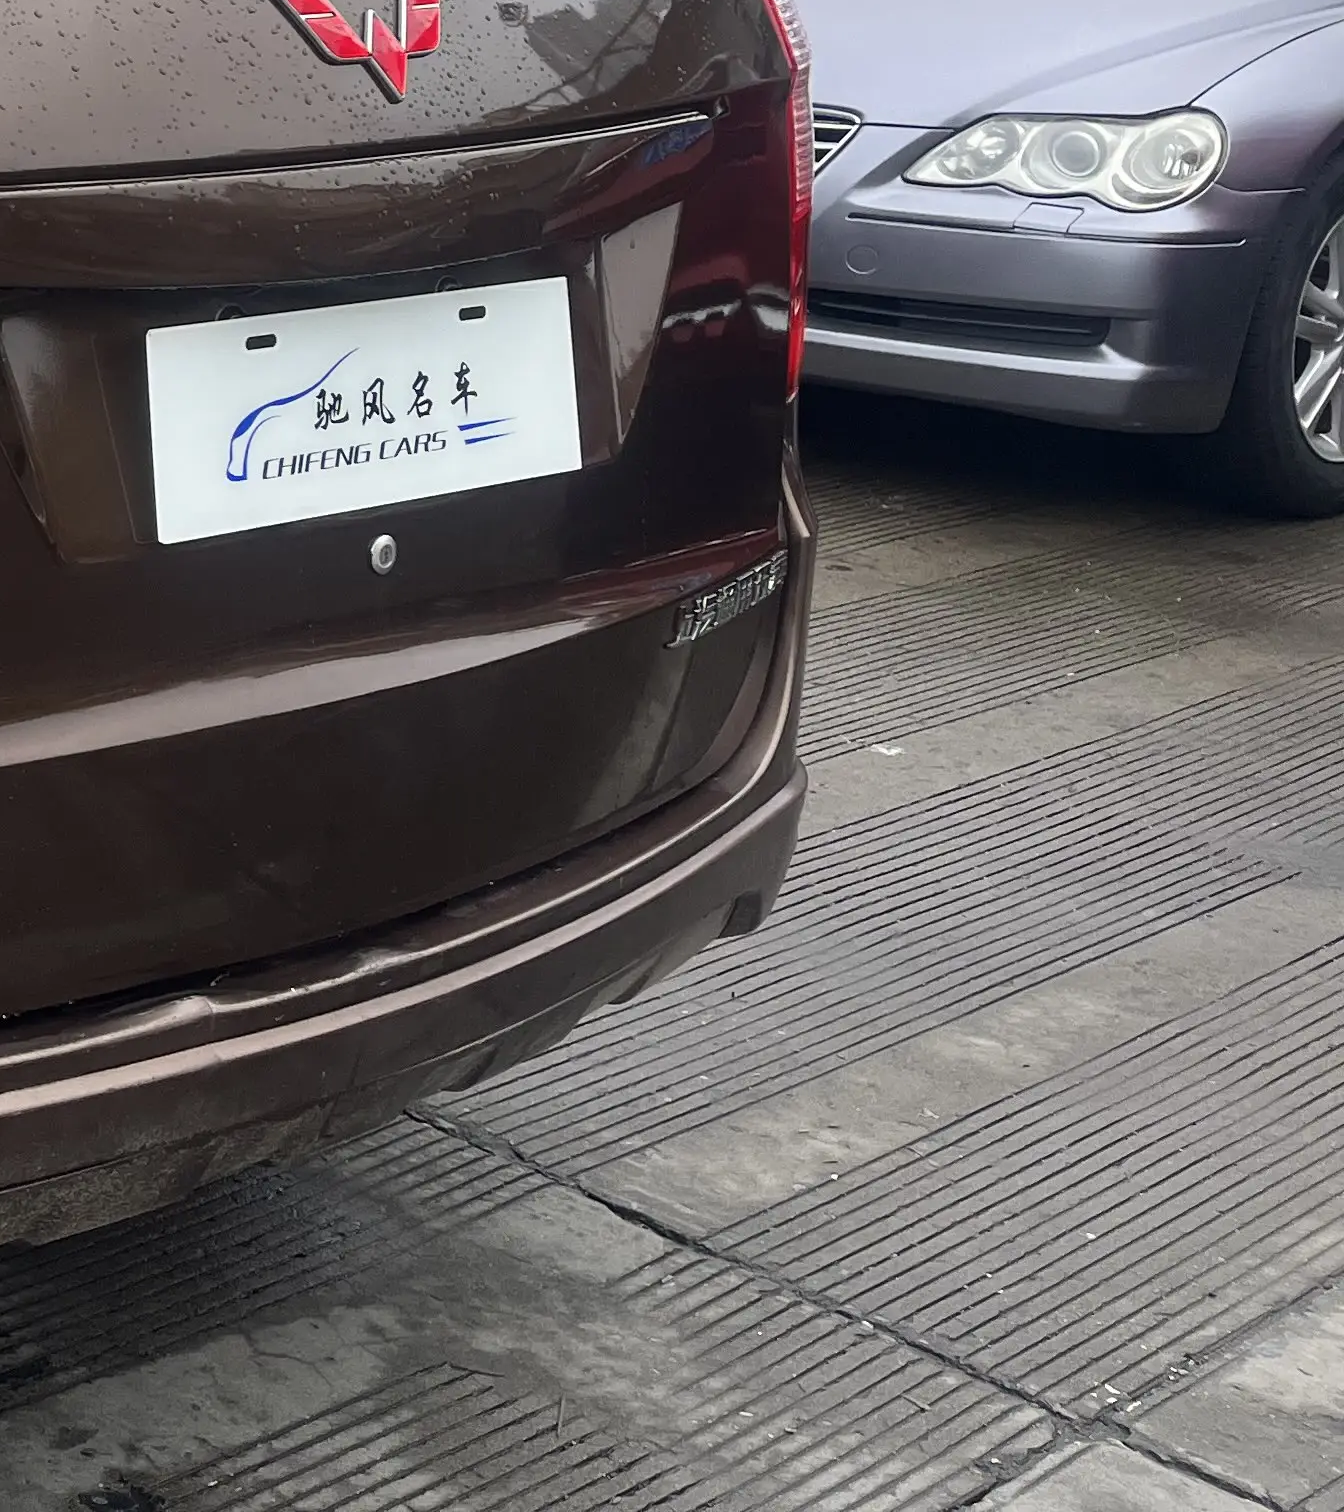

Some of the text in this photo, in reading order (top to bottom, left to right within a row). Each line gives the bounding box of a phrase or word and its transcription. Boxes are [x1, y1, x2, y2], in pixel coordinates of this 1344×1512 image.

[314, 361, 478, 430] 驰风名车
[263, 430, 447, 480] CHIFENG CARS
